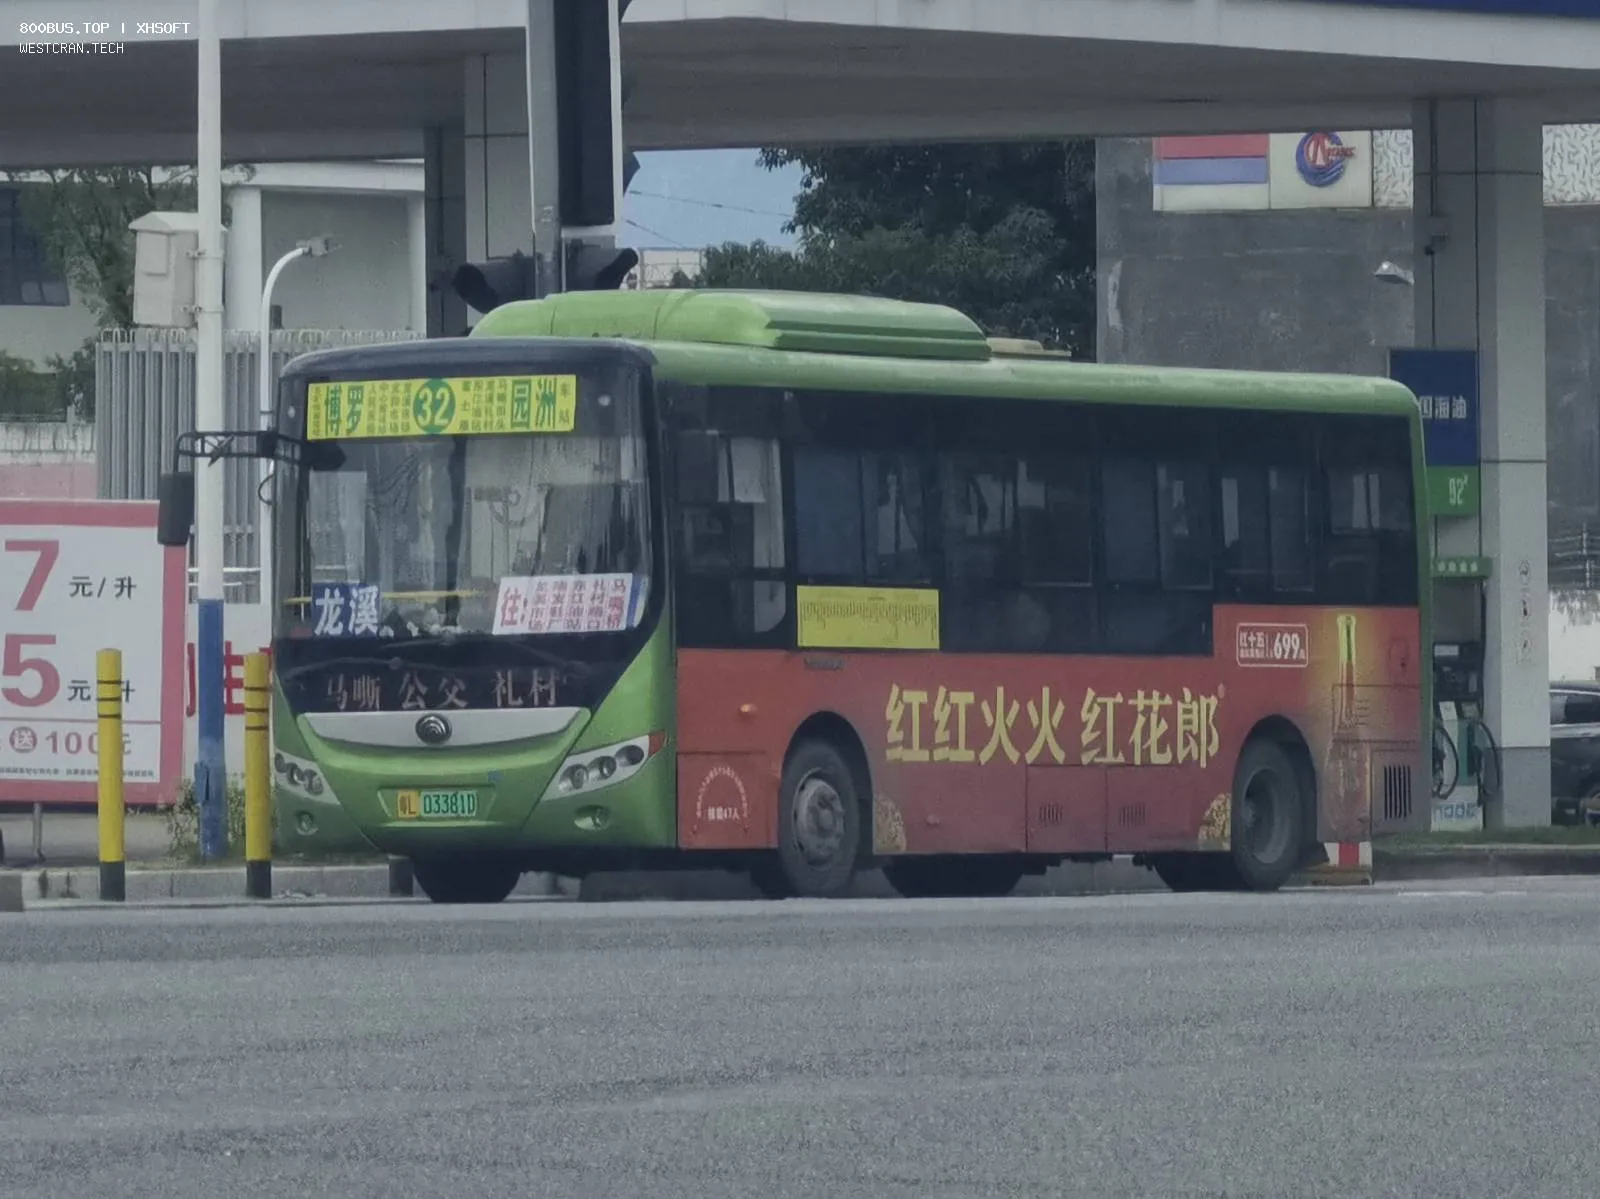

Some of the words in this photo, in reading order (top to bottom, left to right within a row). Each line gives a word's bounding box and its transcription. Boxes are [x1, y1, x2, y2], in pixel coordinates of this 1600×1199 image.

[324, 384, 364, 437] 博罗
[417, 387, 451, 427] 32
[511, 378, 556, 430] 园洲
[5, 540, 59, 612] 7
[69, 575, 137, 599] 元/升
[314, 585, 379, 636] 龙溪
[1, 634, 60, 707] 5
[1274, 632, 1300, 660] 699
[14, 728, 33, 750] 送
[885, 683, 1066, 765] 红红火火
[1081, 686, 1220, 768] 红花郎
[423, 793, 475, 814] 03381D
